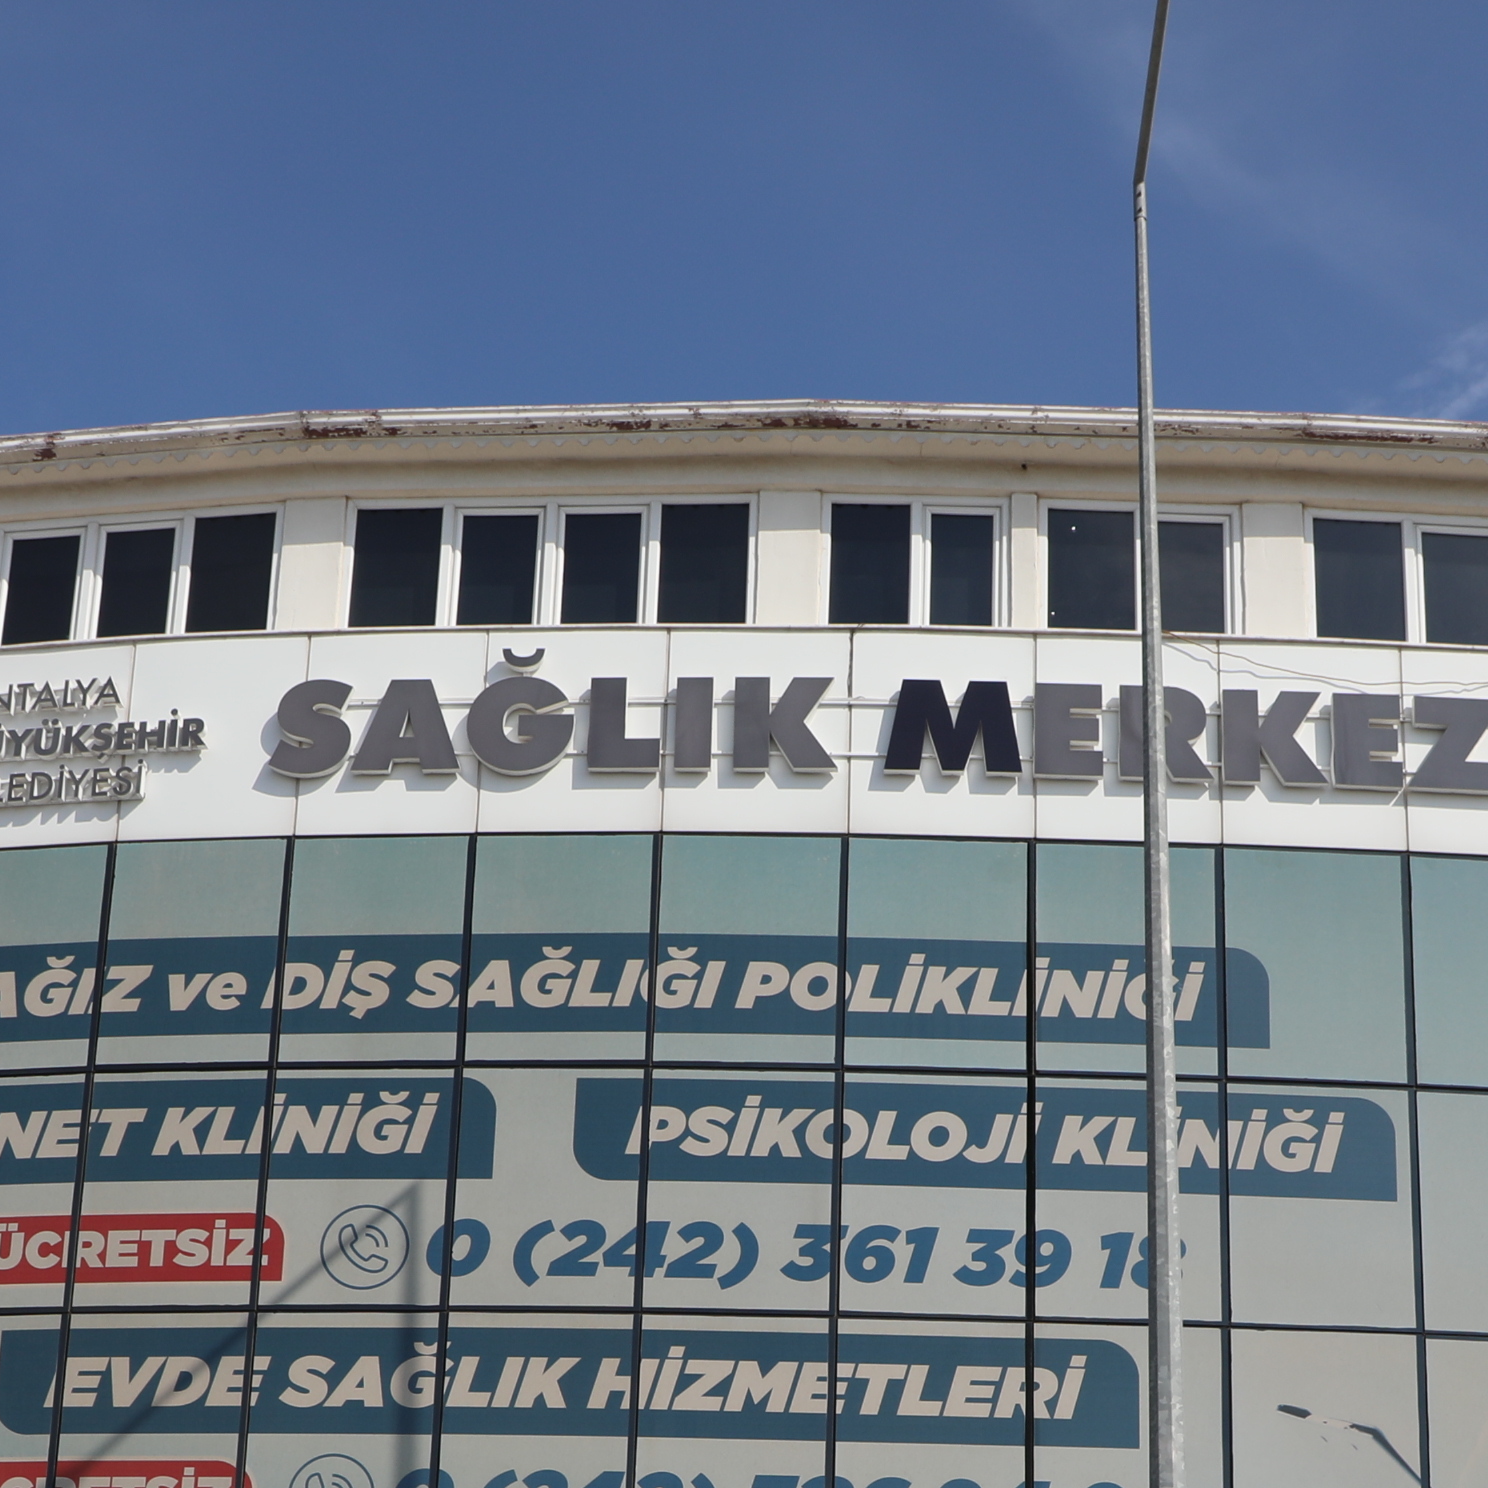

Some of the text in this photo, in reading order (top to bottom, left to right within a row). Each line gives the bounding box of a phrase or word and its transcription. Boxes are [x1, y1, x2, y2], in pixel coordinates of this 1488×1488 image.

[264, 648, 838, 780] SAĞLIK
[168, 971, 248, 1013] ve
[260, 949, 397, 1020] DİŞ
[406, 946, 726, 1010] SAĞLIĞI
[152, 1090, 440, 1155] KLİNİĞİ
[624, 1095, 1346, 1175] PSİKOLOJİ KLNİĞİ
[425, 1218, 1072, 1290] 0 (242) 361 39
[42, 1341, 1088, 1421] EVDE SAĞLIK HİZMETLERİ
